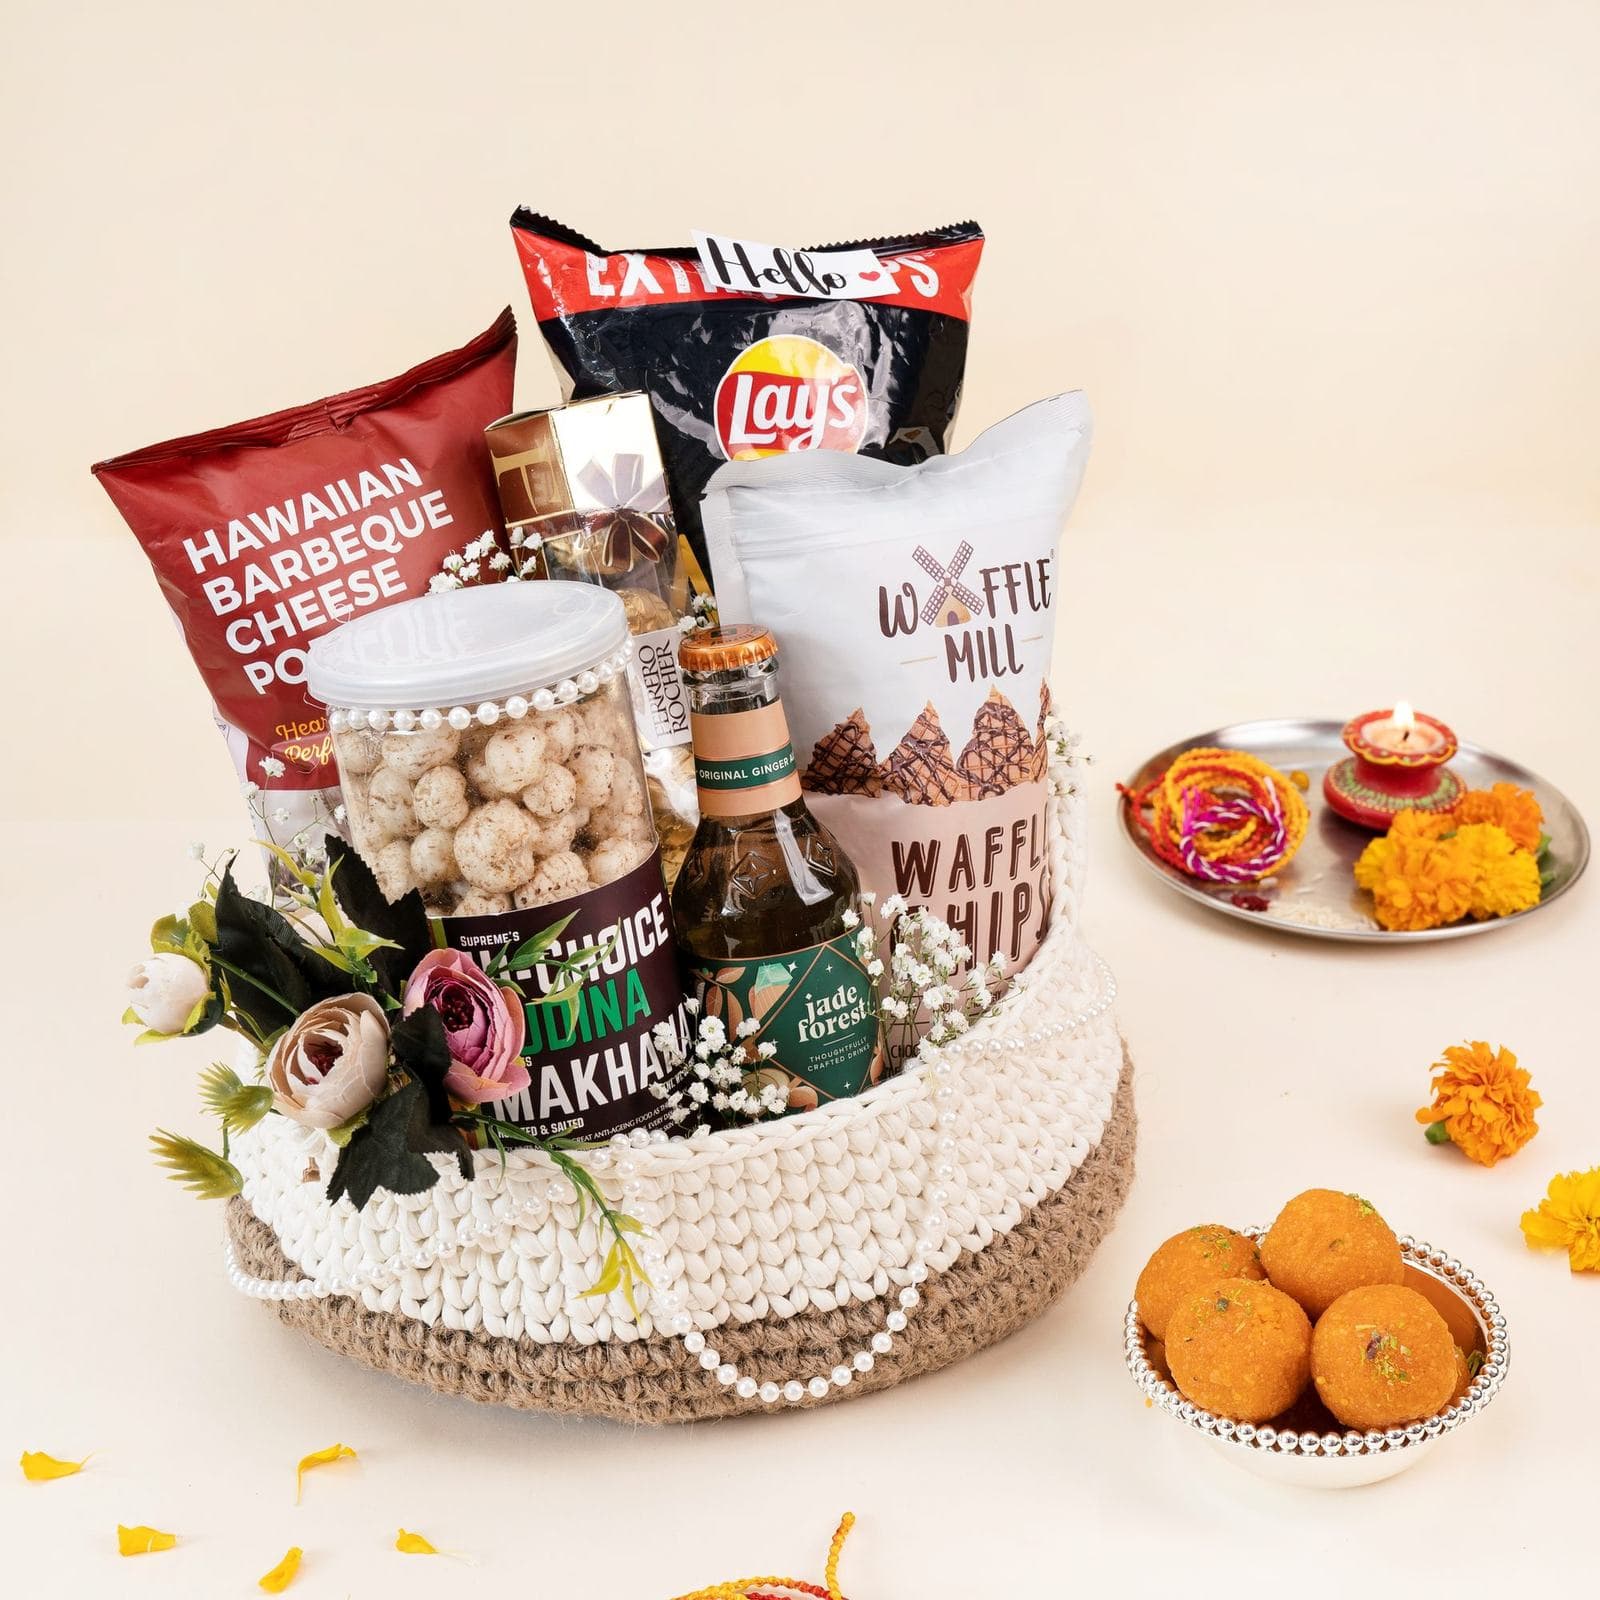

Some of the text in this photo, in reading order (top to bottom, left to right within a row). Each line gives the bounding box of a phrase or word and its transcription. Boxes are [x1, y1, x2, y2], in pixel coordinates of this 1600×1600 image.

[705, 236, 847, 295] Hello
[728, 374, 858, 452] Lay's
[182, 457, 423, 574] HAWAIIAN
[202, 489, 454, 617] BARBEQUE
[225, 557, 407, 654] CHEESE
[944, 623, 1024, 683] MILL
[638, 644, 671, 737] FERRERO
[655, 639, 689, 734] ROCHER
[699, 768, 748, 780] ORIGINAL
[751, 757, 789, 777] GINGER
[460, 930, 520, 947] SUPREME'S
[798, 997, 867, 1043] forest
[805, 984, 858, 1024] jade
[807, 1043, 871, 1072] CRAFTED DRINKS
[809, 1036, 867, 1063] THOUGHTFULLY
[540, 1124, 550, 1136] &
